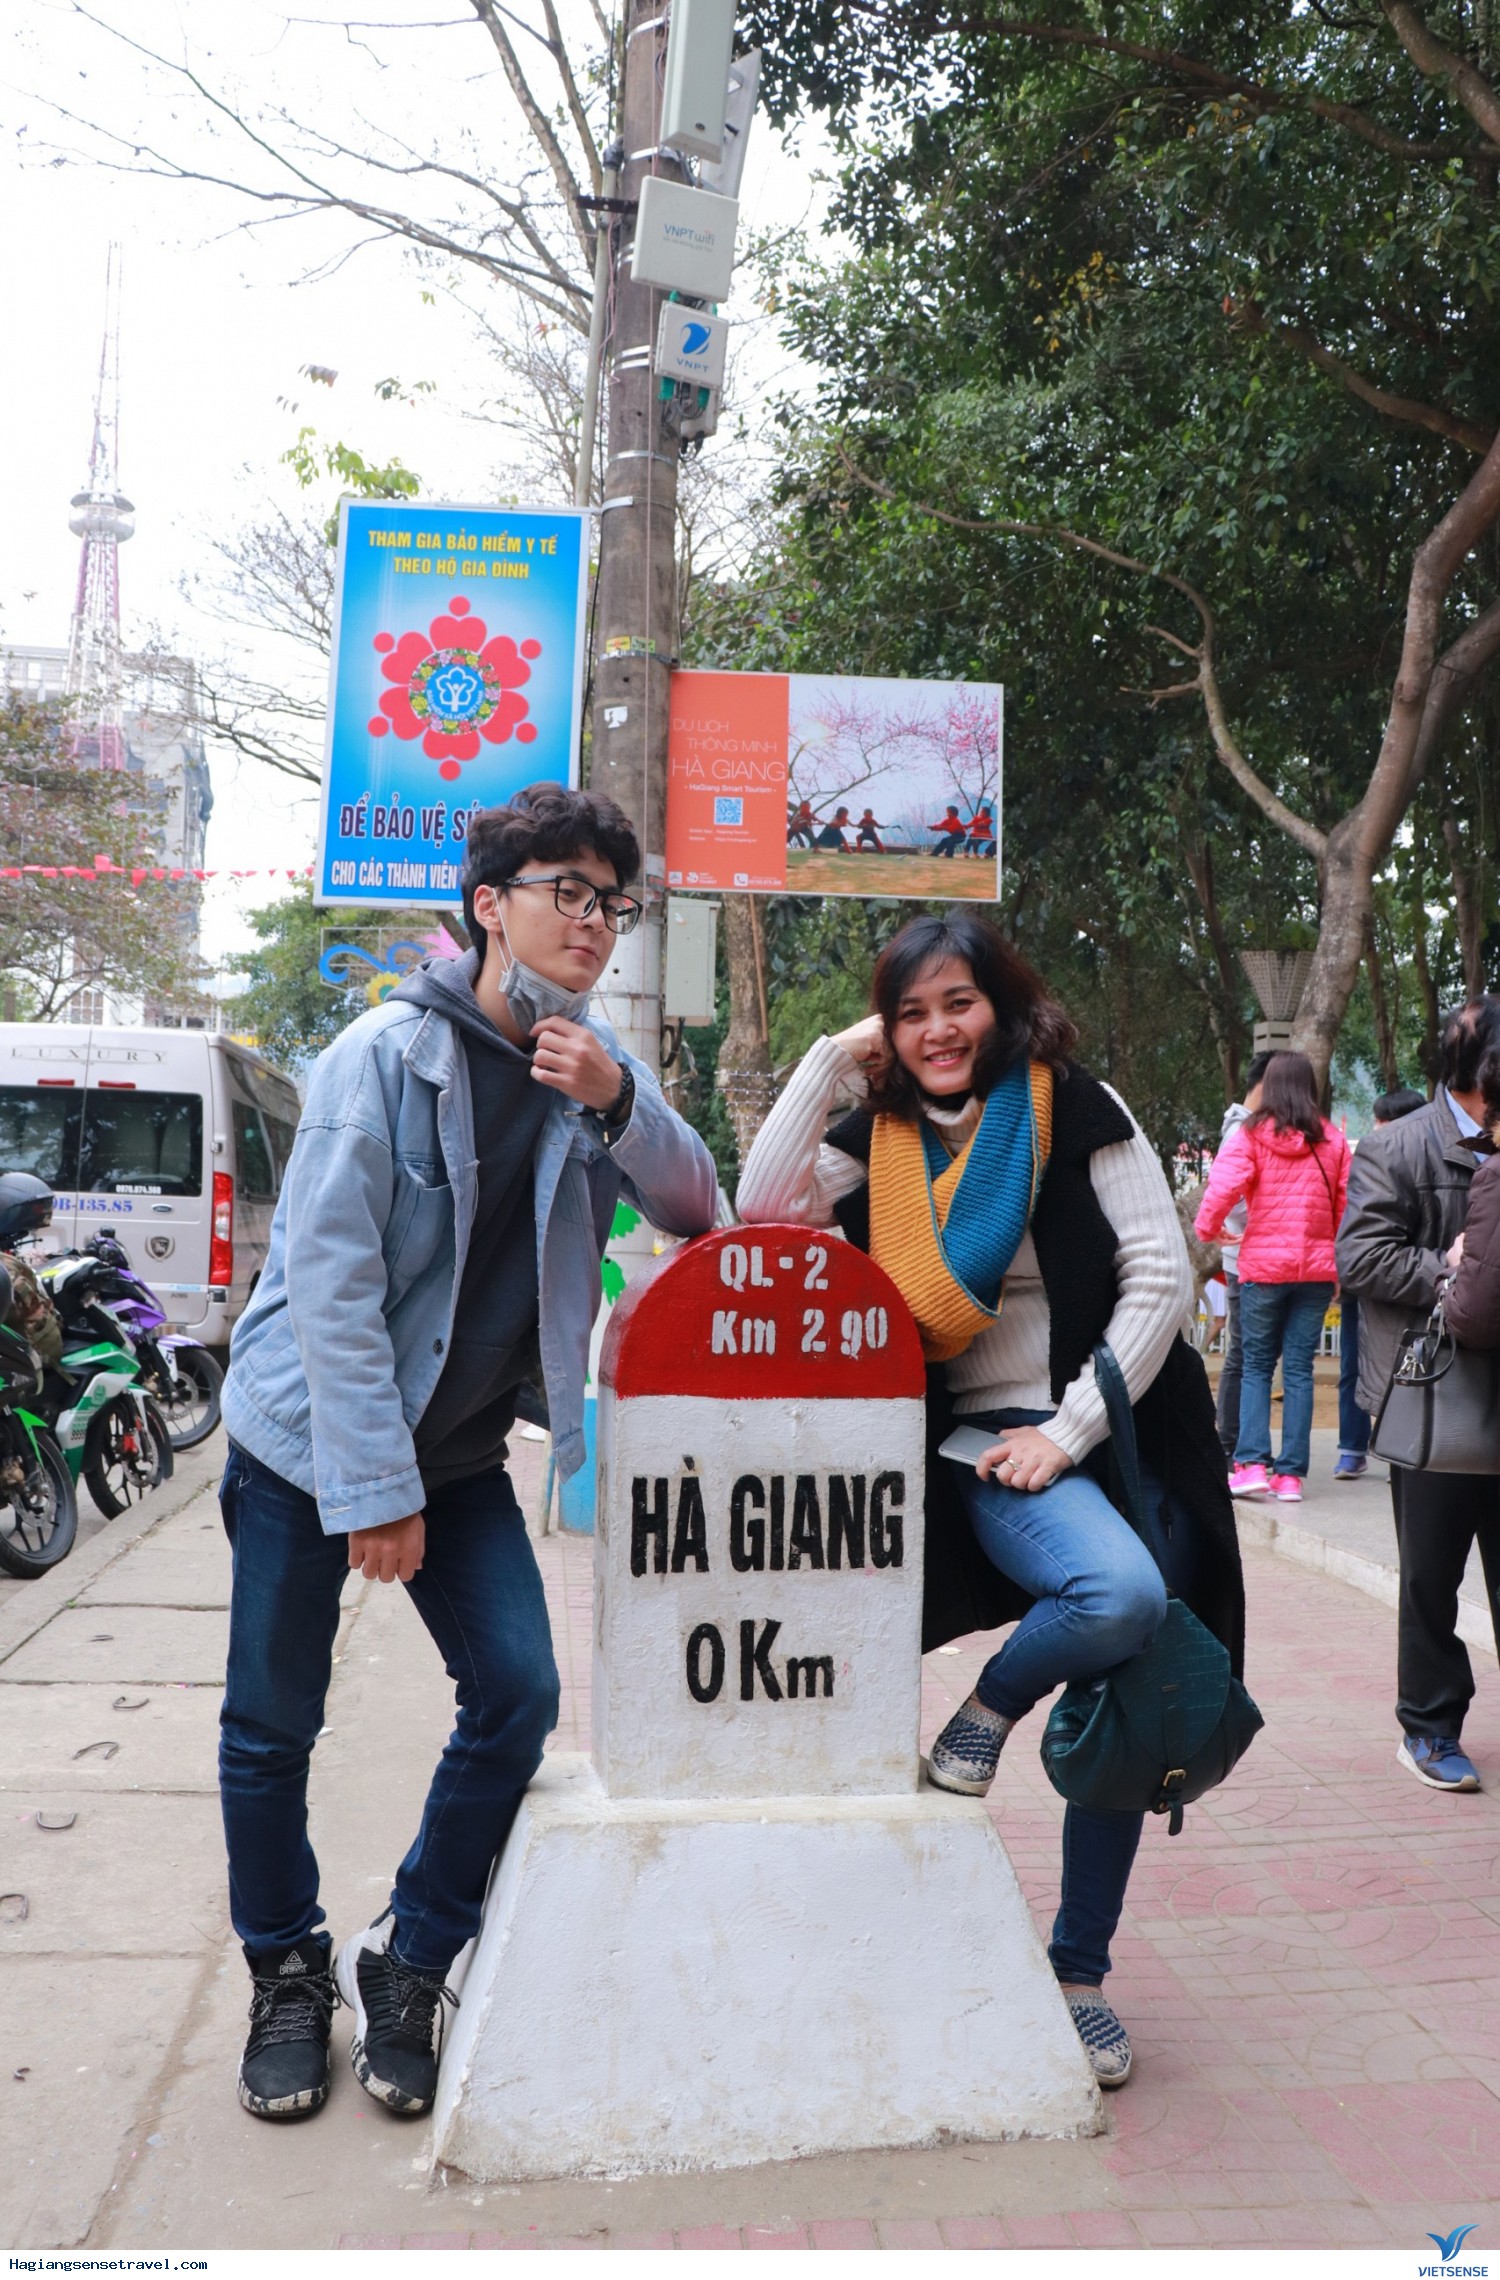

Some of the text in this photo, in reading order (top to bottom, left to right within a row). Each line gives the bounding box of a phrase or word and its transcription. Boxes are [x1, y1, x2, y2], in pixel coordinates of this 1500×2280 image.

[676, 357, 709, 373] VNPT
[368, 528, 559, 555] THAM GIA BẢO HIỂM Y TẾ
[394, 557, 530, 579] THEO HỘ GIA ĐÌNH
[672, 718, 694, 732] DU
[687, 735, 778, 753] THÔNG MINH
[672, 754, 786, 783] HÀ GIANG
[721, 784, 743, 793] Smart
[744, 785, 772, 794] Tourism
[340, 791, 371, 838] ĐỂ
[372, 792, 415, 840] BẢO
[421, 801, 446, 849] VỆ
[331, 857, 458, 890] CHO CÁC THÀNH VIÊN
[11, 1047, 166, 1063] LUXURY
[711, 1310, 777, 1357] Km
[630, 1455, 906, 1578] HÀ GIANG
[685, 1618, 835, 1704] 0 Km
[279, 1963, 308, 1975] PEAK
